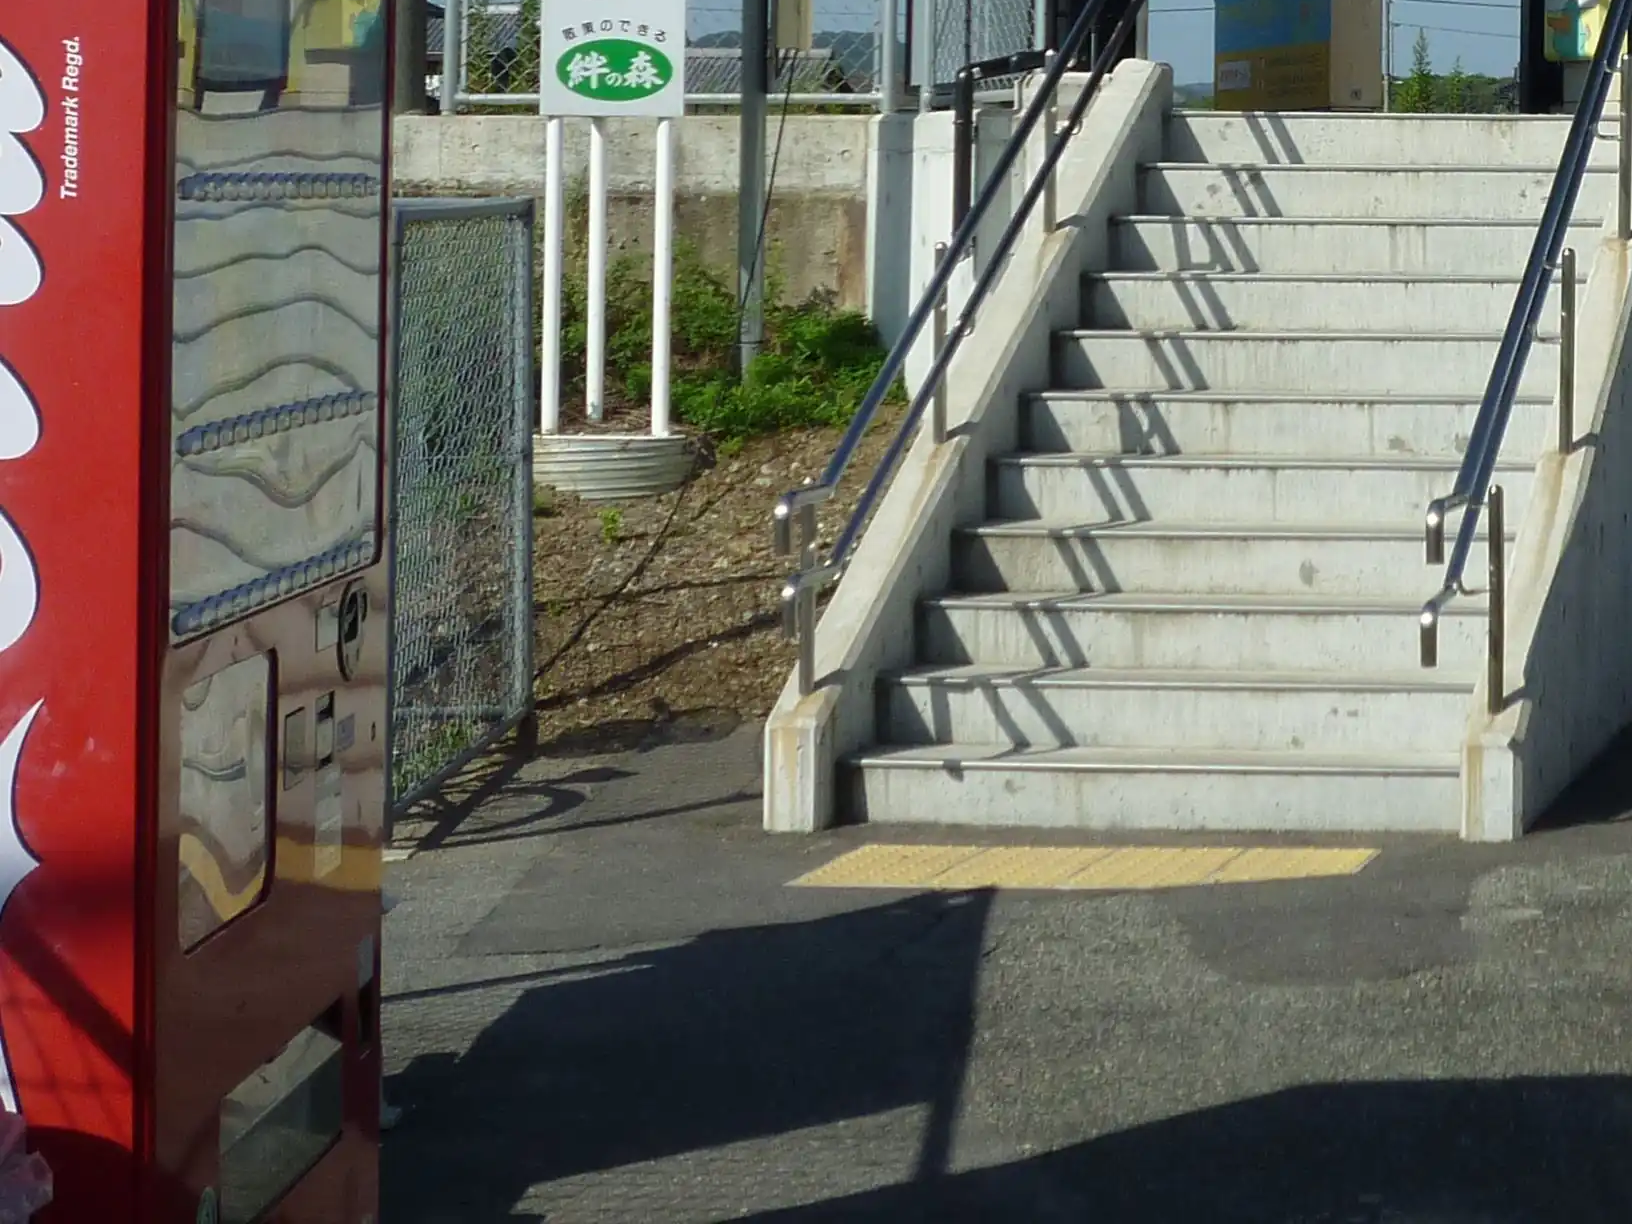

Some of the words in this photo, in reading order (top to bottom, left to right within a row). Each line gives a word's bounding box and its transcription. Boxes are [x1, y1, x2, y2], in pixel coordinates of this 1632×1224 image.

[61, 36, 83, 92] Regd.
[565, 50, 665, 89] 絆の森
[60, 95, 79, 200] Trademark
